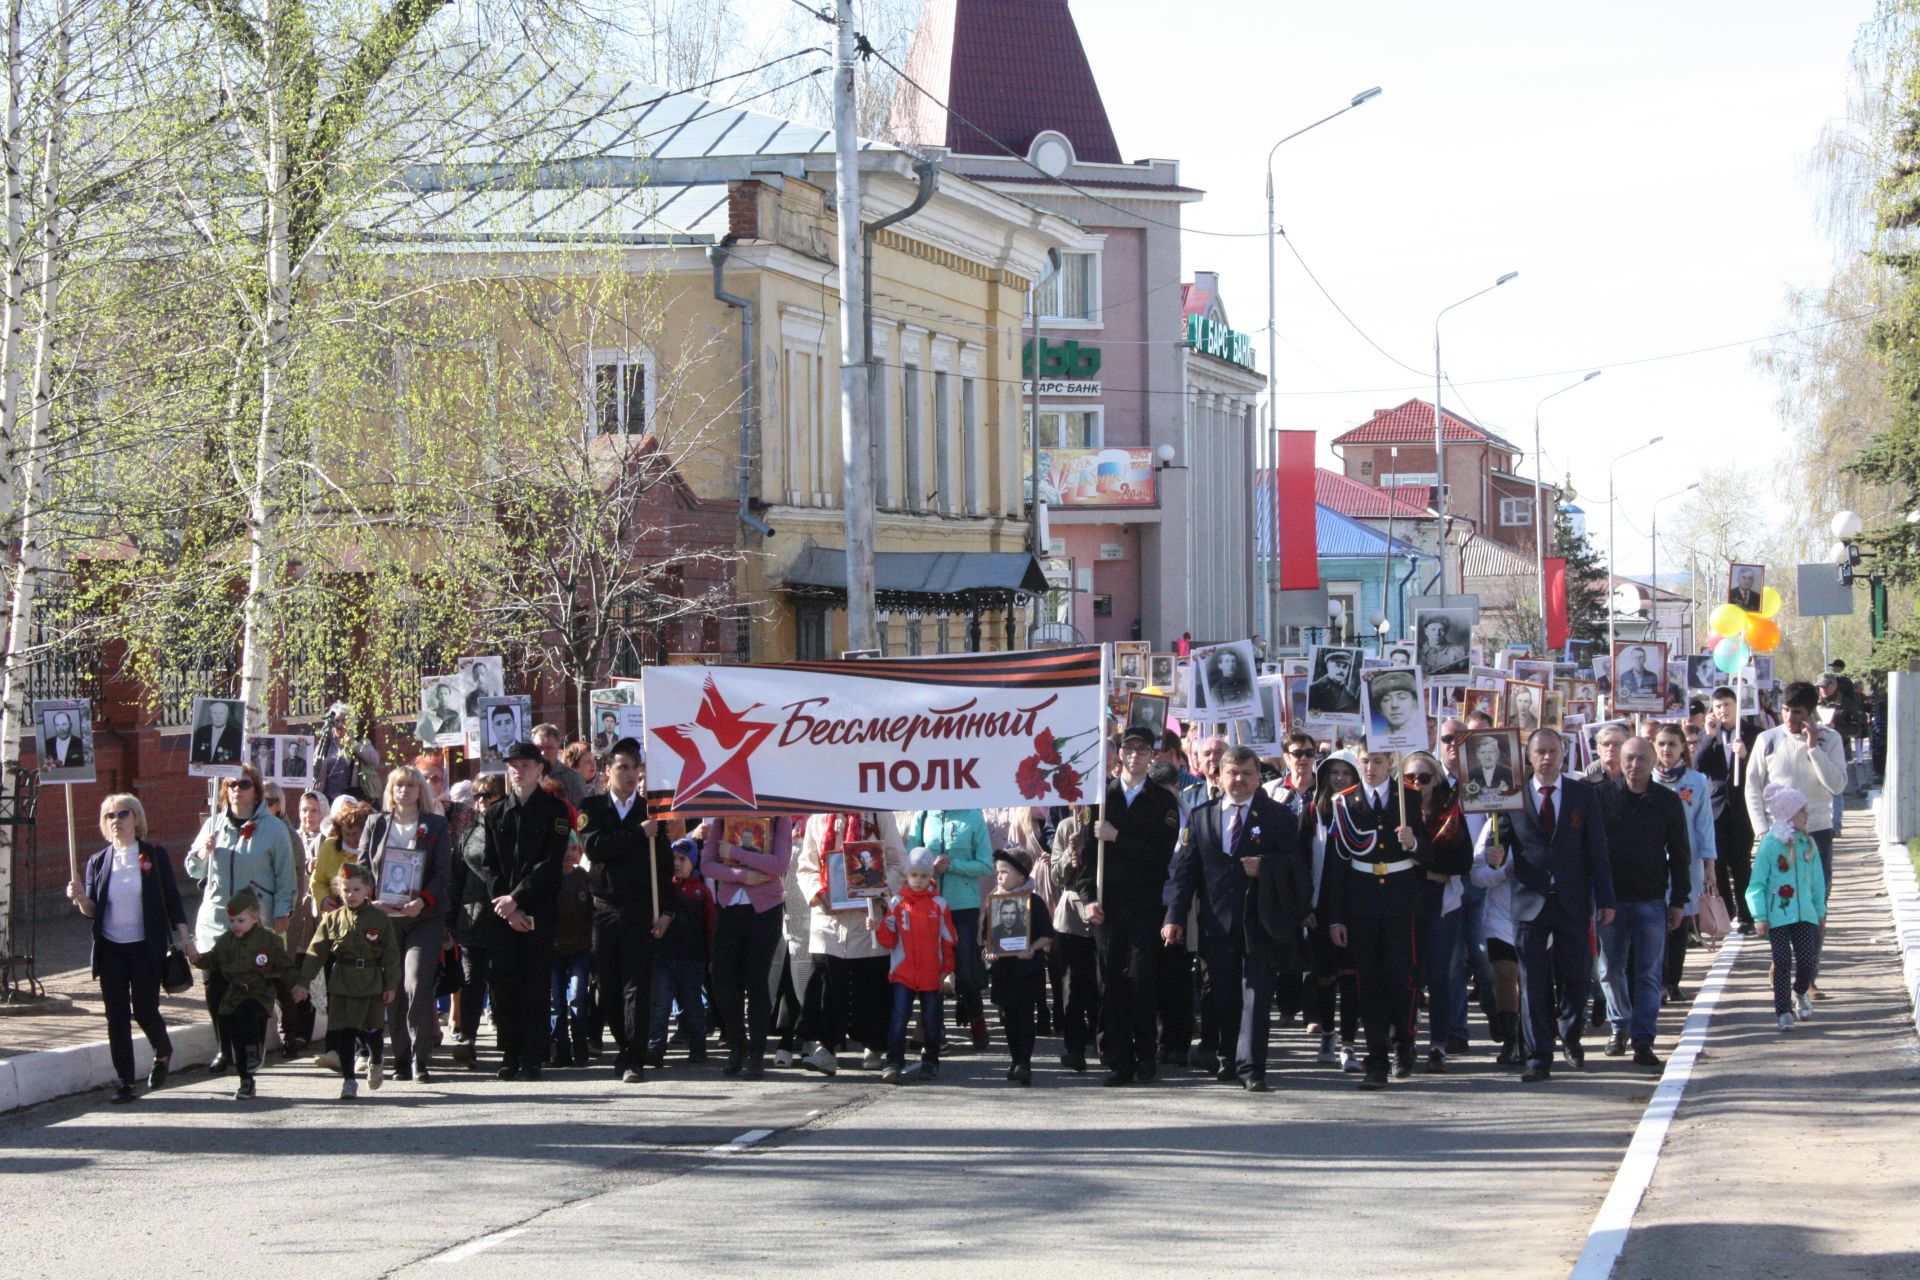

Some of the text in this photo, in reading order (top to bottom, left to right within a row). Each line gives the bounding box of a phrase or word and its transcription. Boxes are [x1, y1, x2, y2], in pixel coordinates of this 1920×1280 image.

[1207, 319, 1229, 360] БАРС
[1232, 330, 1251, 369] БАНК
[1031, 382, 1064, 394] АРС
[1066, 382, 1100, 394] БАНК
[778, 693, 1059, 752] Бессмертный
[858, 757, 981, 794] ПОЛК
